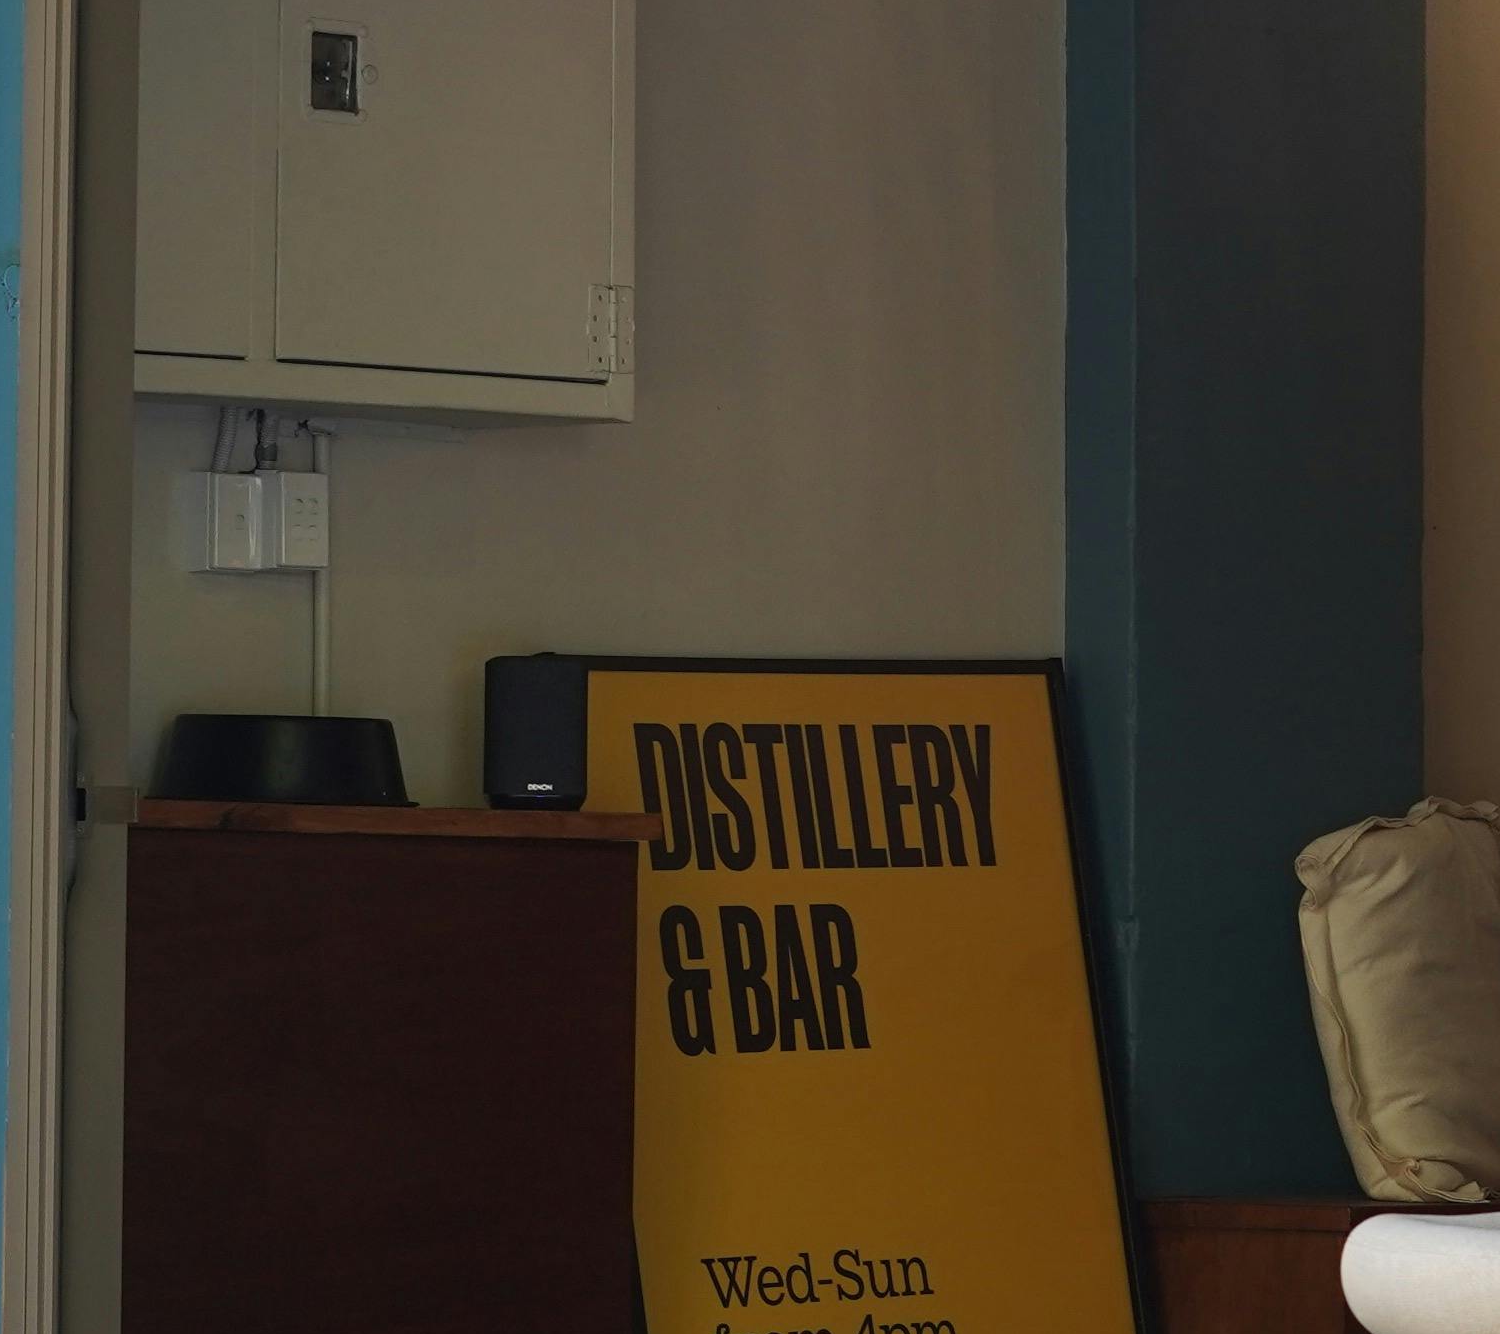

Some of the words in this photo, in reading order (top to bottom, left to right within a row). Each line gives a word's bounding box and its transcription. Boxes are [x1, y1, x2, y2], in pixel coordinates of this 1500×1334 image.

[526, 783, 553, 791] DENON
[632, 721, 998, 871] DISTILLERY
[658, 904, 716, 1056] &
[718, 903, 872, 1054] BAR
[700, 1248, 935, 1309] Wed-Sun
